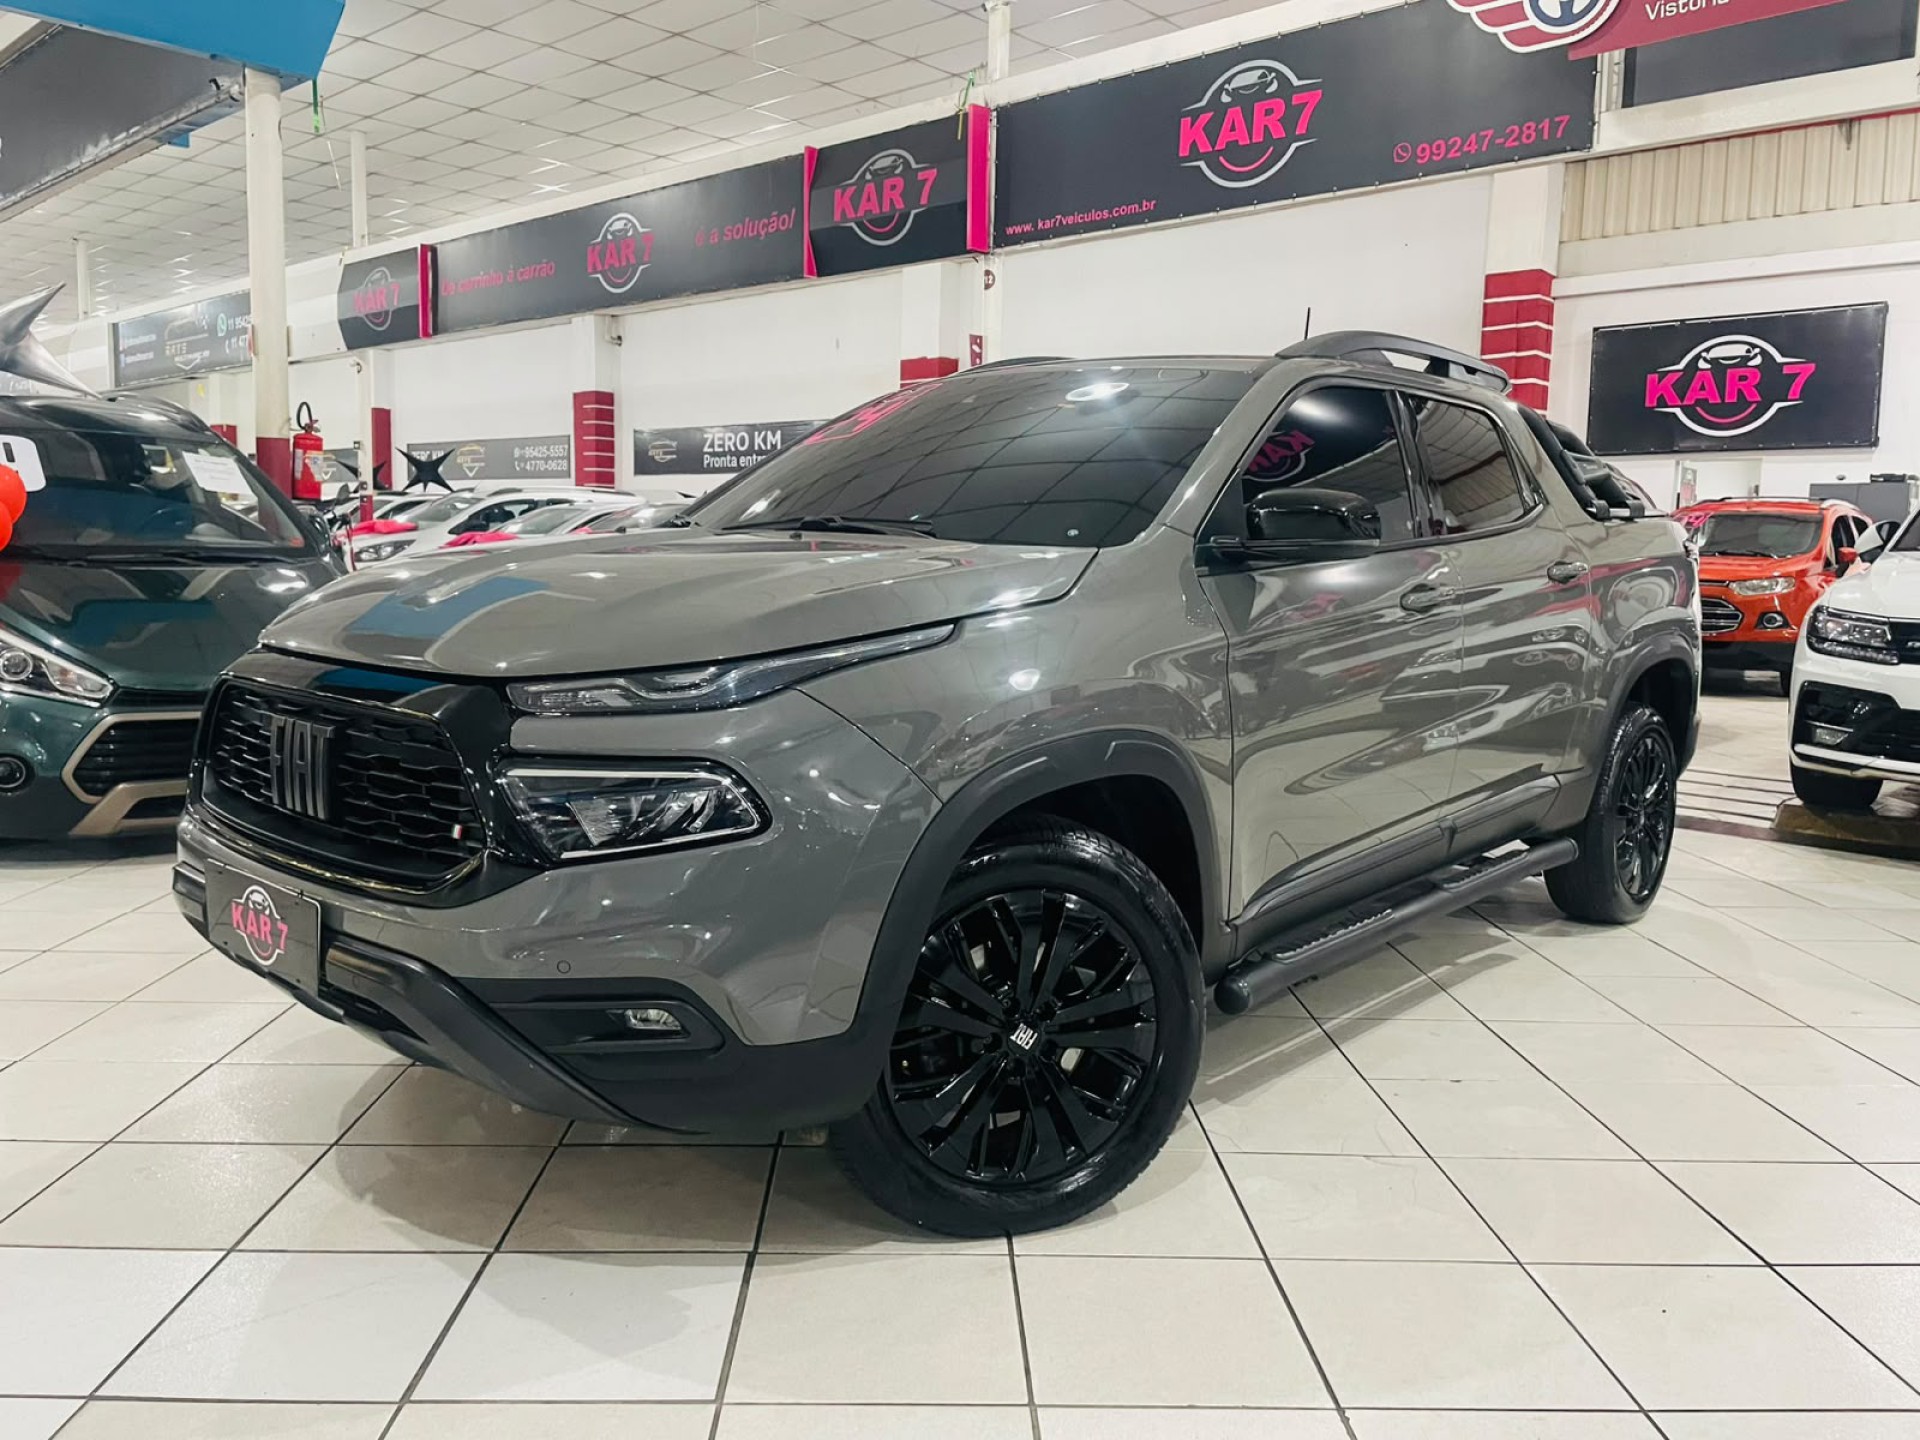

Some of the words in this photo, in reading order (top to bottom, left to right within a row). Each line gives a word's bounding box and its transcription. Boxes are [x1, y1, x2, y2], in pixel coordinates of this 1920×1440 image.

[1179, 98, 1287, 157] KAR
[1292, 90, 1323, 135] 7
[1416, 115, 1571, 165] 99247-2817
[834, 177, 905, 222] KAR
[917, 168, 938, 205] 7
[709, 230, 720, 245] a
[723, 208, 797, 241] solução!
[1005, 223, 1034, 236] www.
[1037, 200, 1157, 230] kar7veiculos.com.br
[587, 238, 637, 274] KAR
[642, 232, 655, 262] 7
[354, 286, 388, 314] KAR
[391, 283, 401, 306] 7
[1645, 367, 1762, 408] KAR
[1782, 363, 1817, 400] 7
[703, 431, 750, 452] ZERO
[754, 429, 781, 451] KM
[703, 453, 738, 468] Pronta
[269, 714, 336, 820] FIAT
[232, 902, 273, 946] KAR
[276, 922, 288, 950] 7
[1009, 1022, 1039, 1051] FIAT
